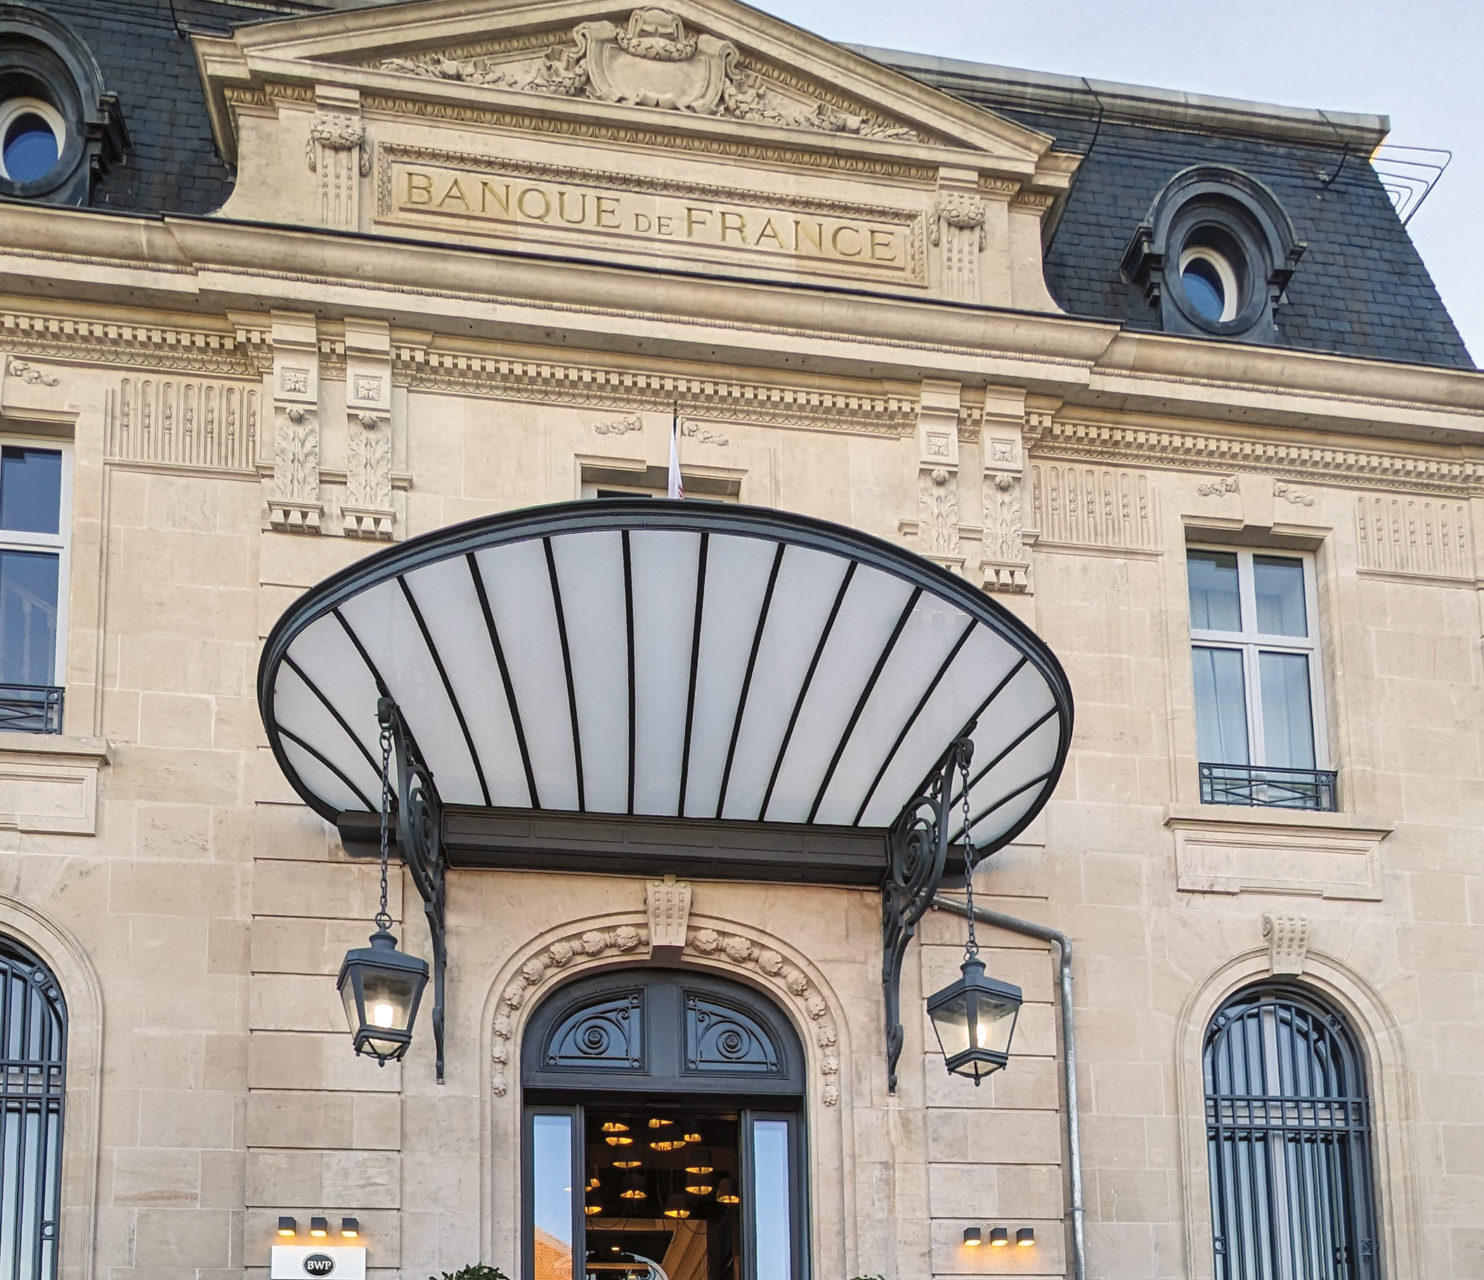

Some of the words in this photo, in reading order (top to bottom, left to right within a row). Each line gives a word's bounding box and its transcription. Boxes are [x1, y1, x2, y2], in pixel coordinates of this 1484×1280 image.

[404, 171, 623, 229] BANQUE
[634, 212, 674, 236] DE
[684, 206, 898, 262] FRANCE
[307, 1260, 332, 1270] BWP
